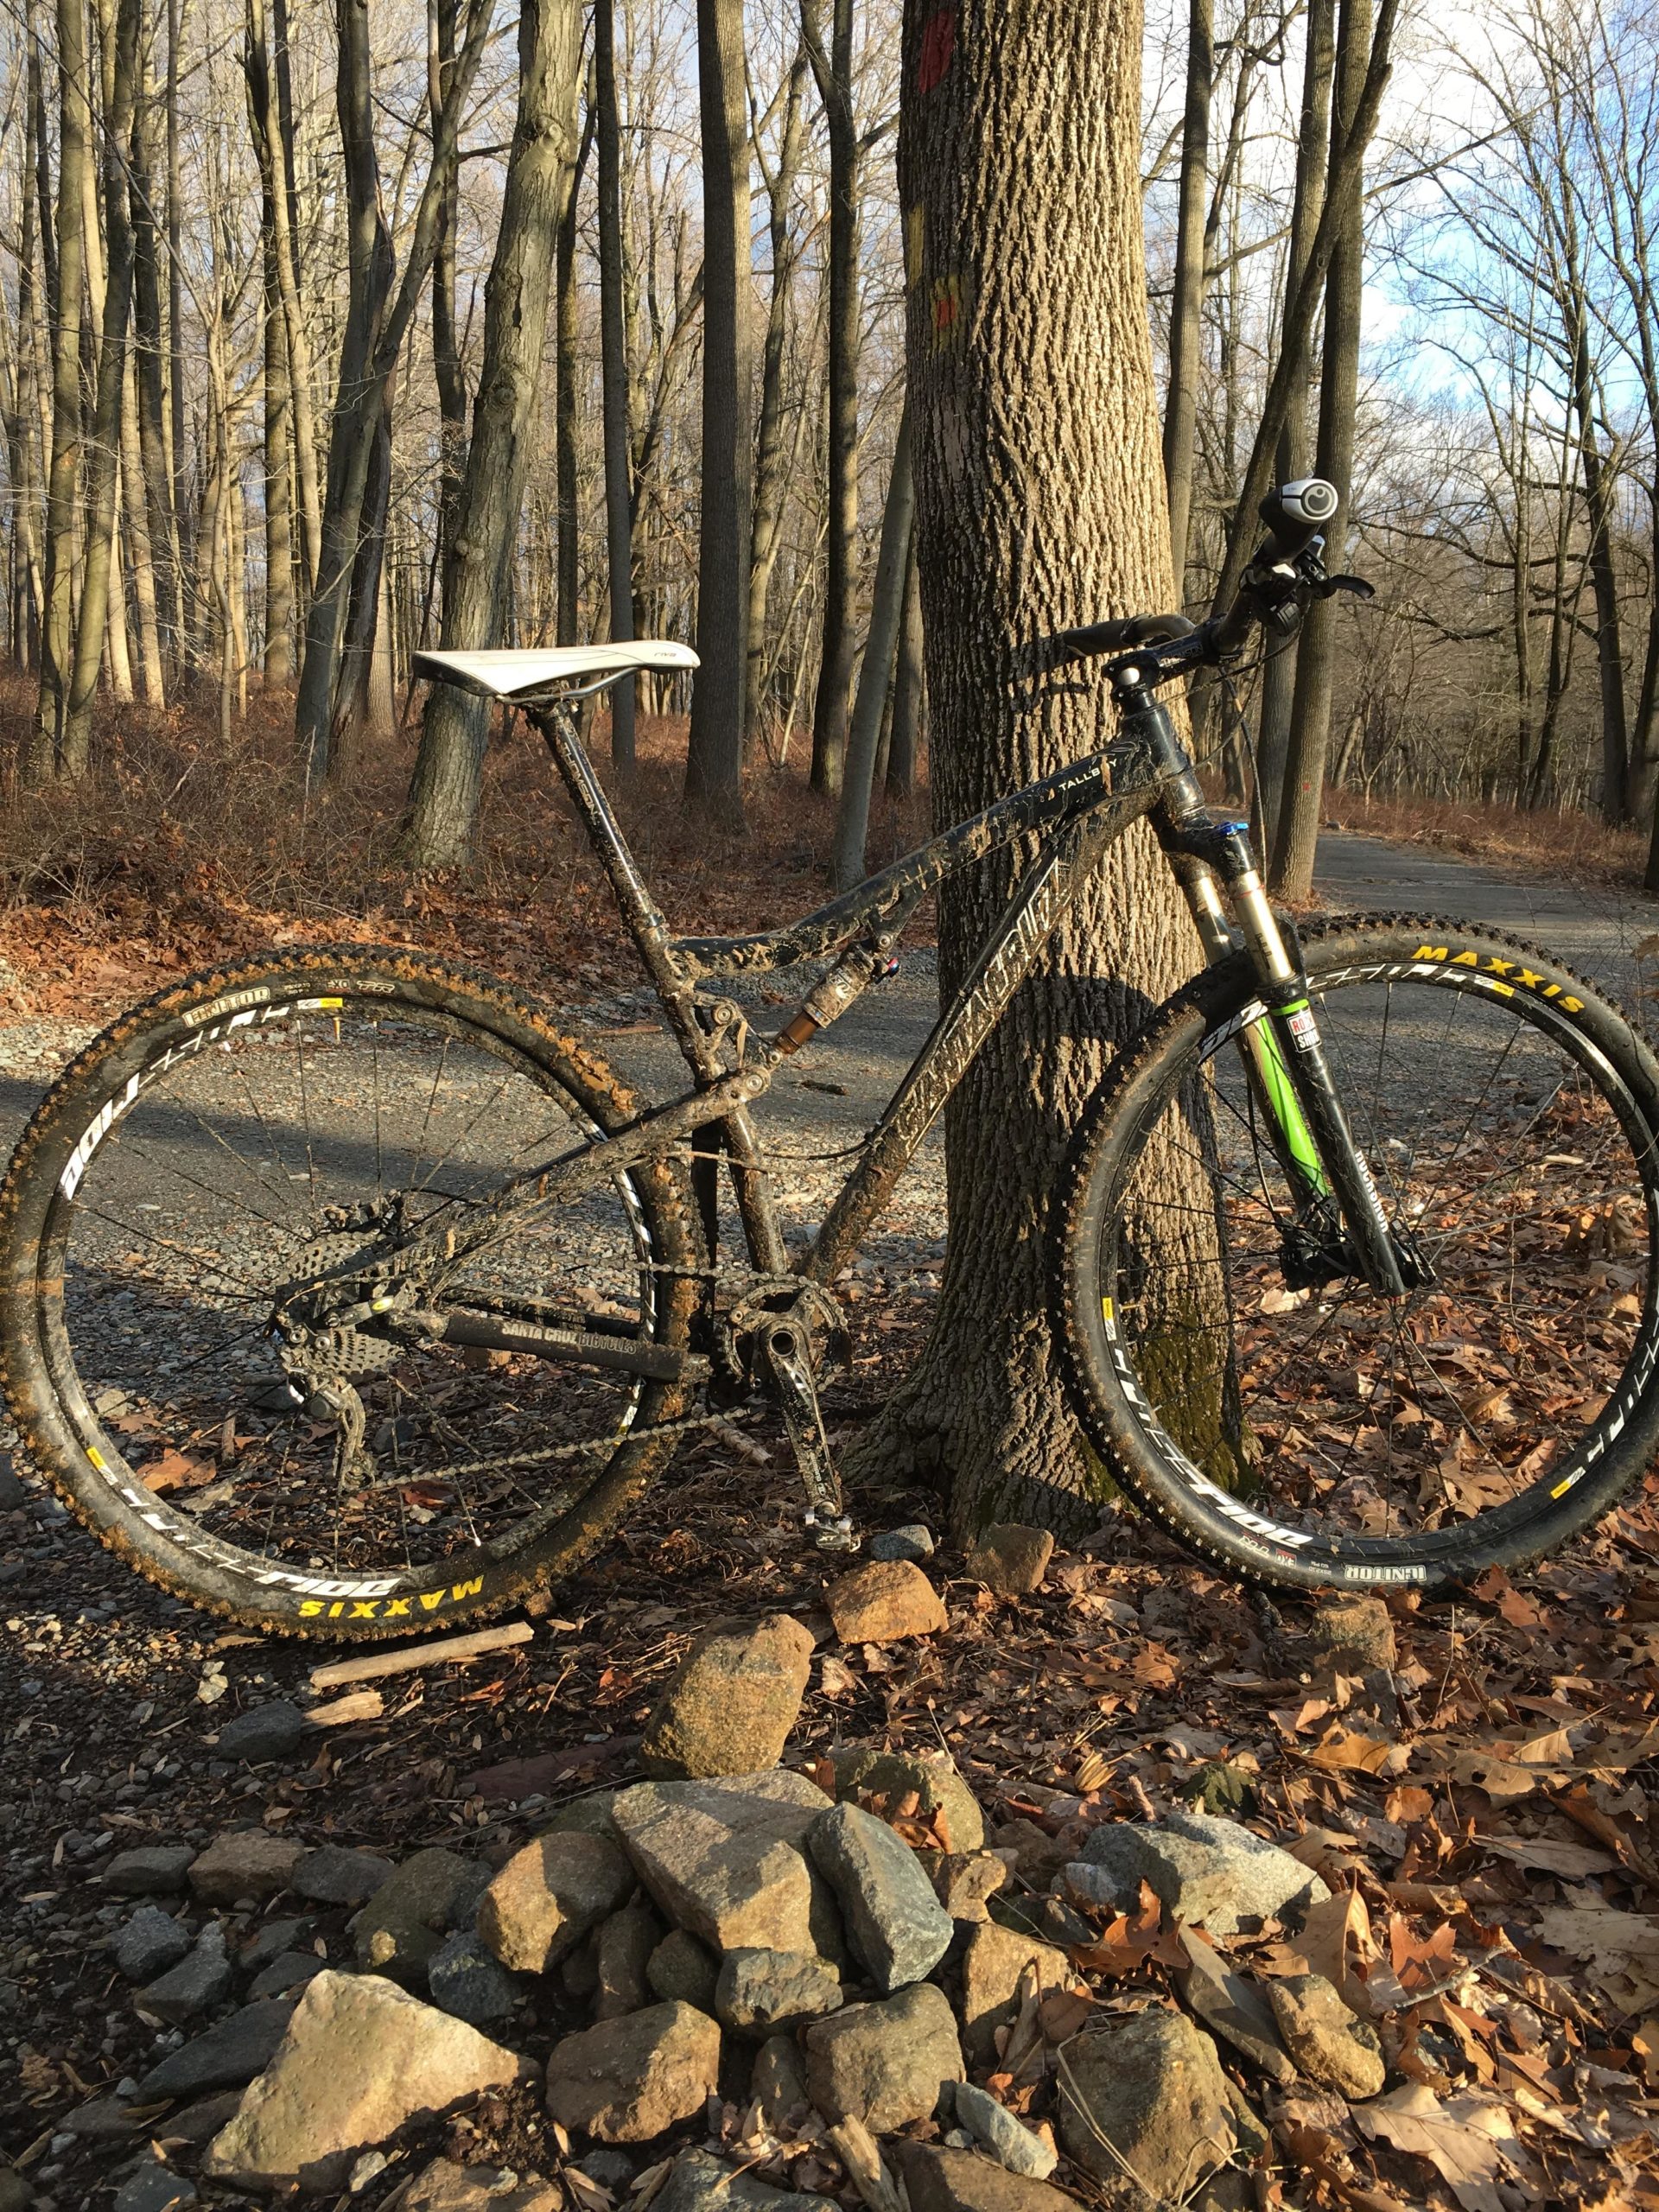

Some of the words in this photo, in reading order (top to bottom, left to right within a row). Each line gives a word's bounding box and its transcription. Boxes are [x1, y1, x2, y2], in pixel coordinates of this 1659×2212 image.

[563, 741, 595, 820] THOMSON
[1058, 758, 1117, 791] TALLBY
[356, 980, 395, 994] TR
[1411, 945, 1585, 1014] MAXXIS
[182, 986, 270, 1028] IGNITOR
[502, 1322, 543, 1339] SANTA
[544, 1327, 578, 1344] CRUZ
[578, 1332, 638, 1355] BICYCLES
[1344, 1565, 1427, 1582] IGNITOR
[298, 1574, 485, 1619] MAXXIS
